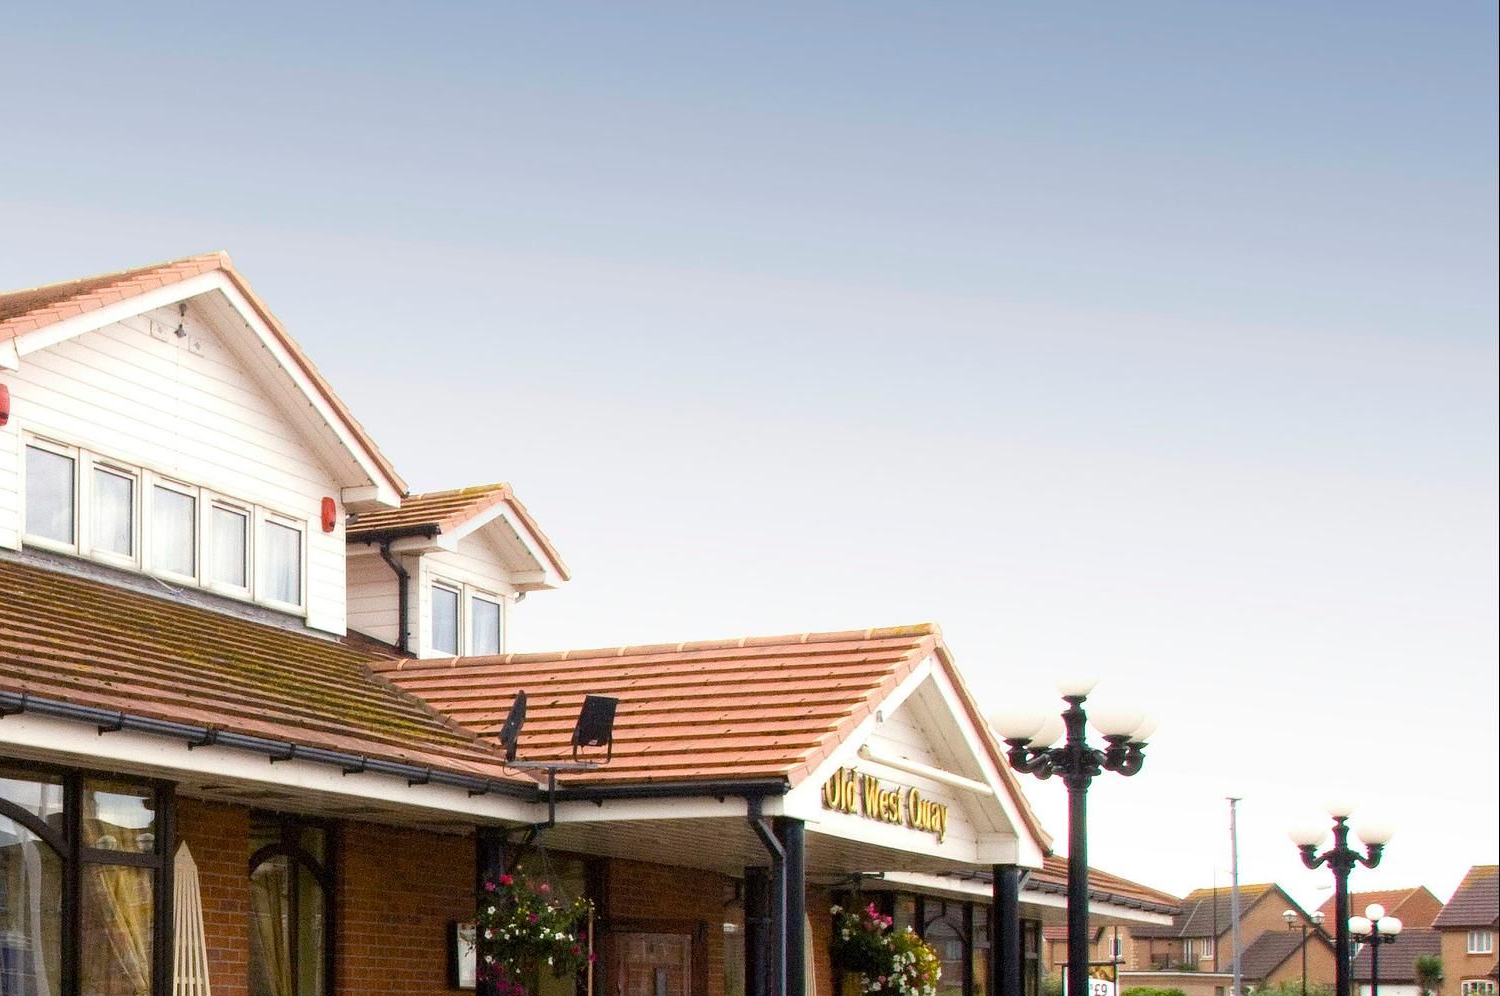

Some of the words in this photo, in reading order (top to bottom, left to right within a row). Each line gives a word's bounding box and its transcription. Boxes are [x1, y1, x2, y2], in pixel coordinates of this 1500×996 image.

[822, 765, 858, 814] Old
[861, 773, 902, 826] West
[906, 786, 948, 844] Quay
[1094, 983, 1107, 996] £9
